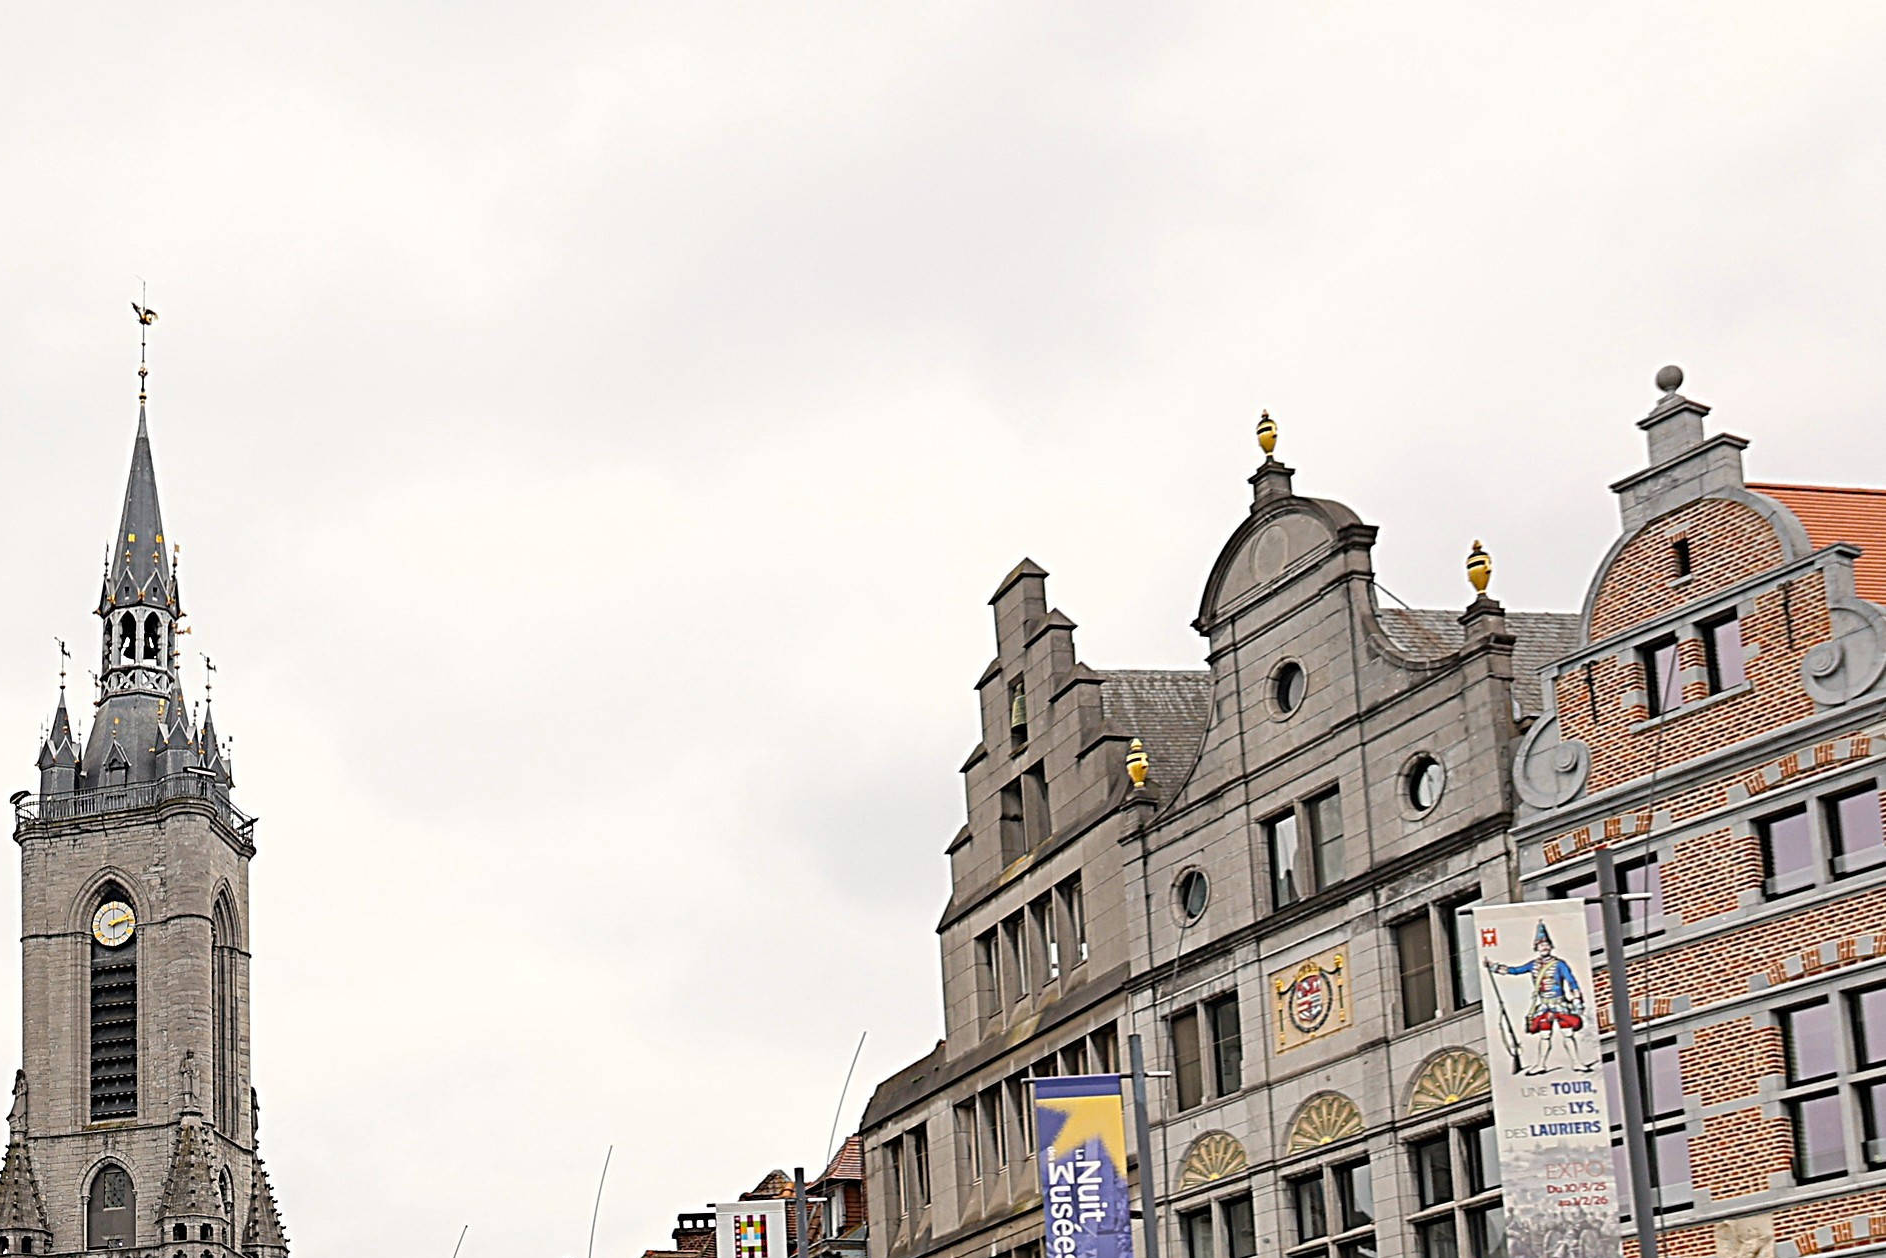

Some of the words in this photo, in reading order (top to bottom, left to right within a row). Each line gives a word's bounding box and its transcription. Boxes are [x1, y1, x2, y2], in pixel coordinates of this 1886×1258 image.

[1521, 1087, 1548, 1098] UNE
[1551, 1081, 1597, 1095] TOUR,
[1544, 1106, 1566, 1116] DES
[1569, 1101, 1599, 1114] LYS,
[1505, 1128, 1527, 1139] DES
[1530, 1121, 1601, 1137] LAURIERS
[1546, 1160, 1605, 1179] EXPO
[1075, 1160, 1108, 1223] Nuit
